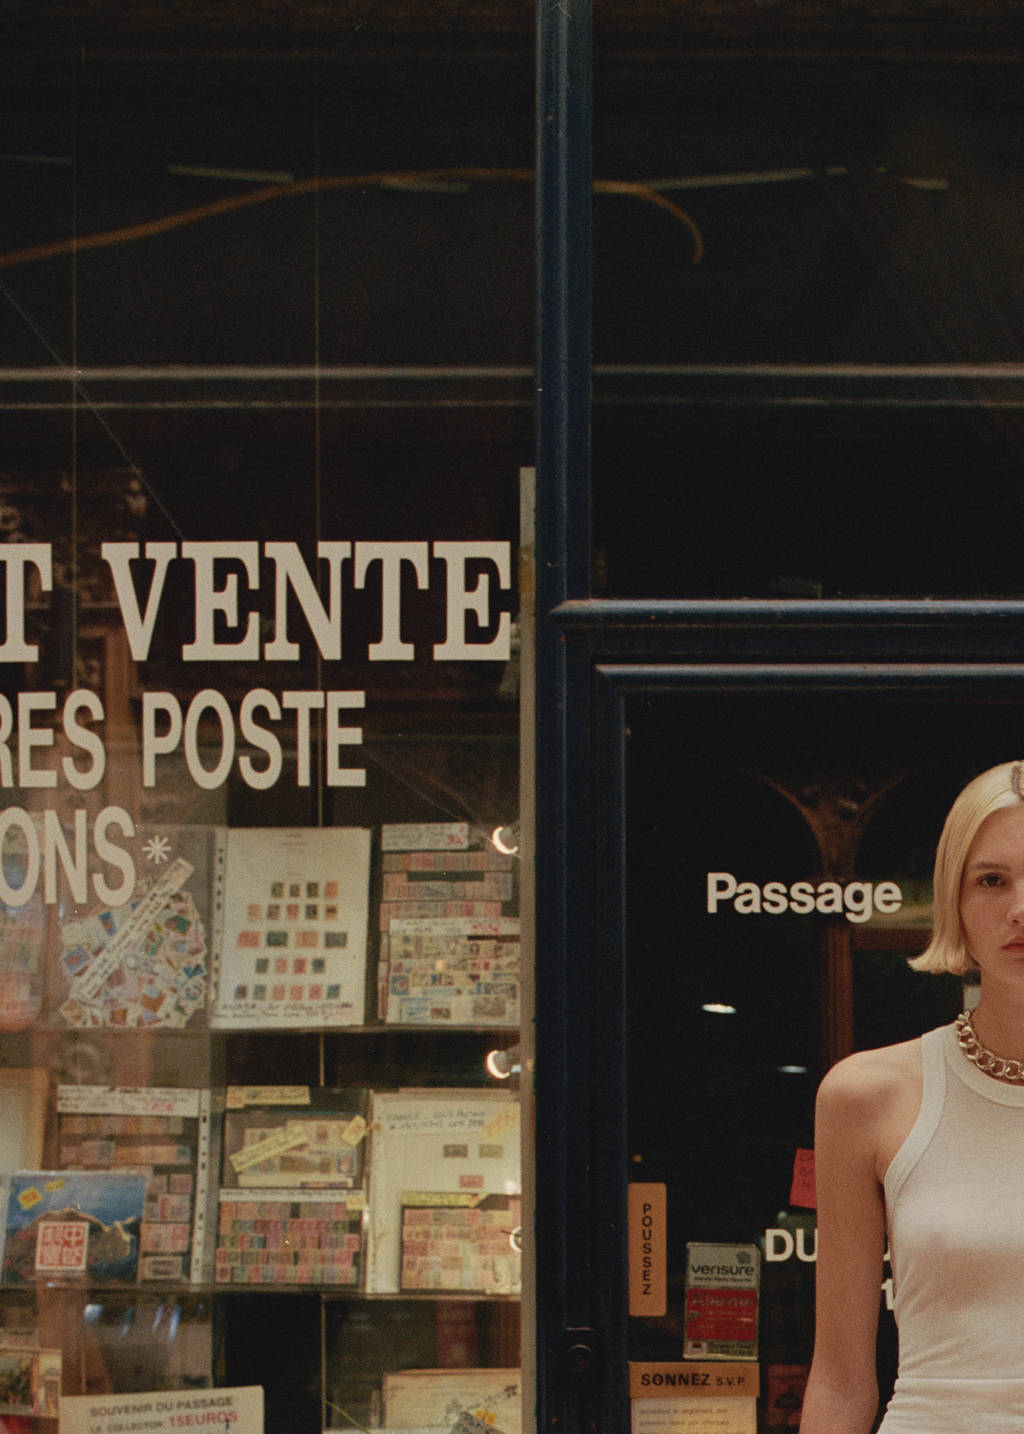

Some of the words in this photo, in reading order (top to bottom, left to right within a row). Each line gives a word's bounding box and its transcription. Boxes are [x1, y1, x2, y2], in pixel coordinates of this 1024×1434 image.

[101, 541, 512, 661] VENTE
[142, 688, 366, 790] POSTE
[706, 872, 902, 923] Passage
[641, 1203, 653, 1295] POUSSEZ
[766, 1228, 817, 1262] DU
[691, 1263, 755, 1277] verisure
[641, 1373, 711, 1387] SONNEZ
[90, 1404, 152, 1418] SOUVENIR
[156, 1402, 173, 1412] DU
[176, 1396, 233, 1410] PASSAGE
[169, 1410, 238, 1428] 15EUROS
